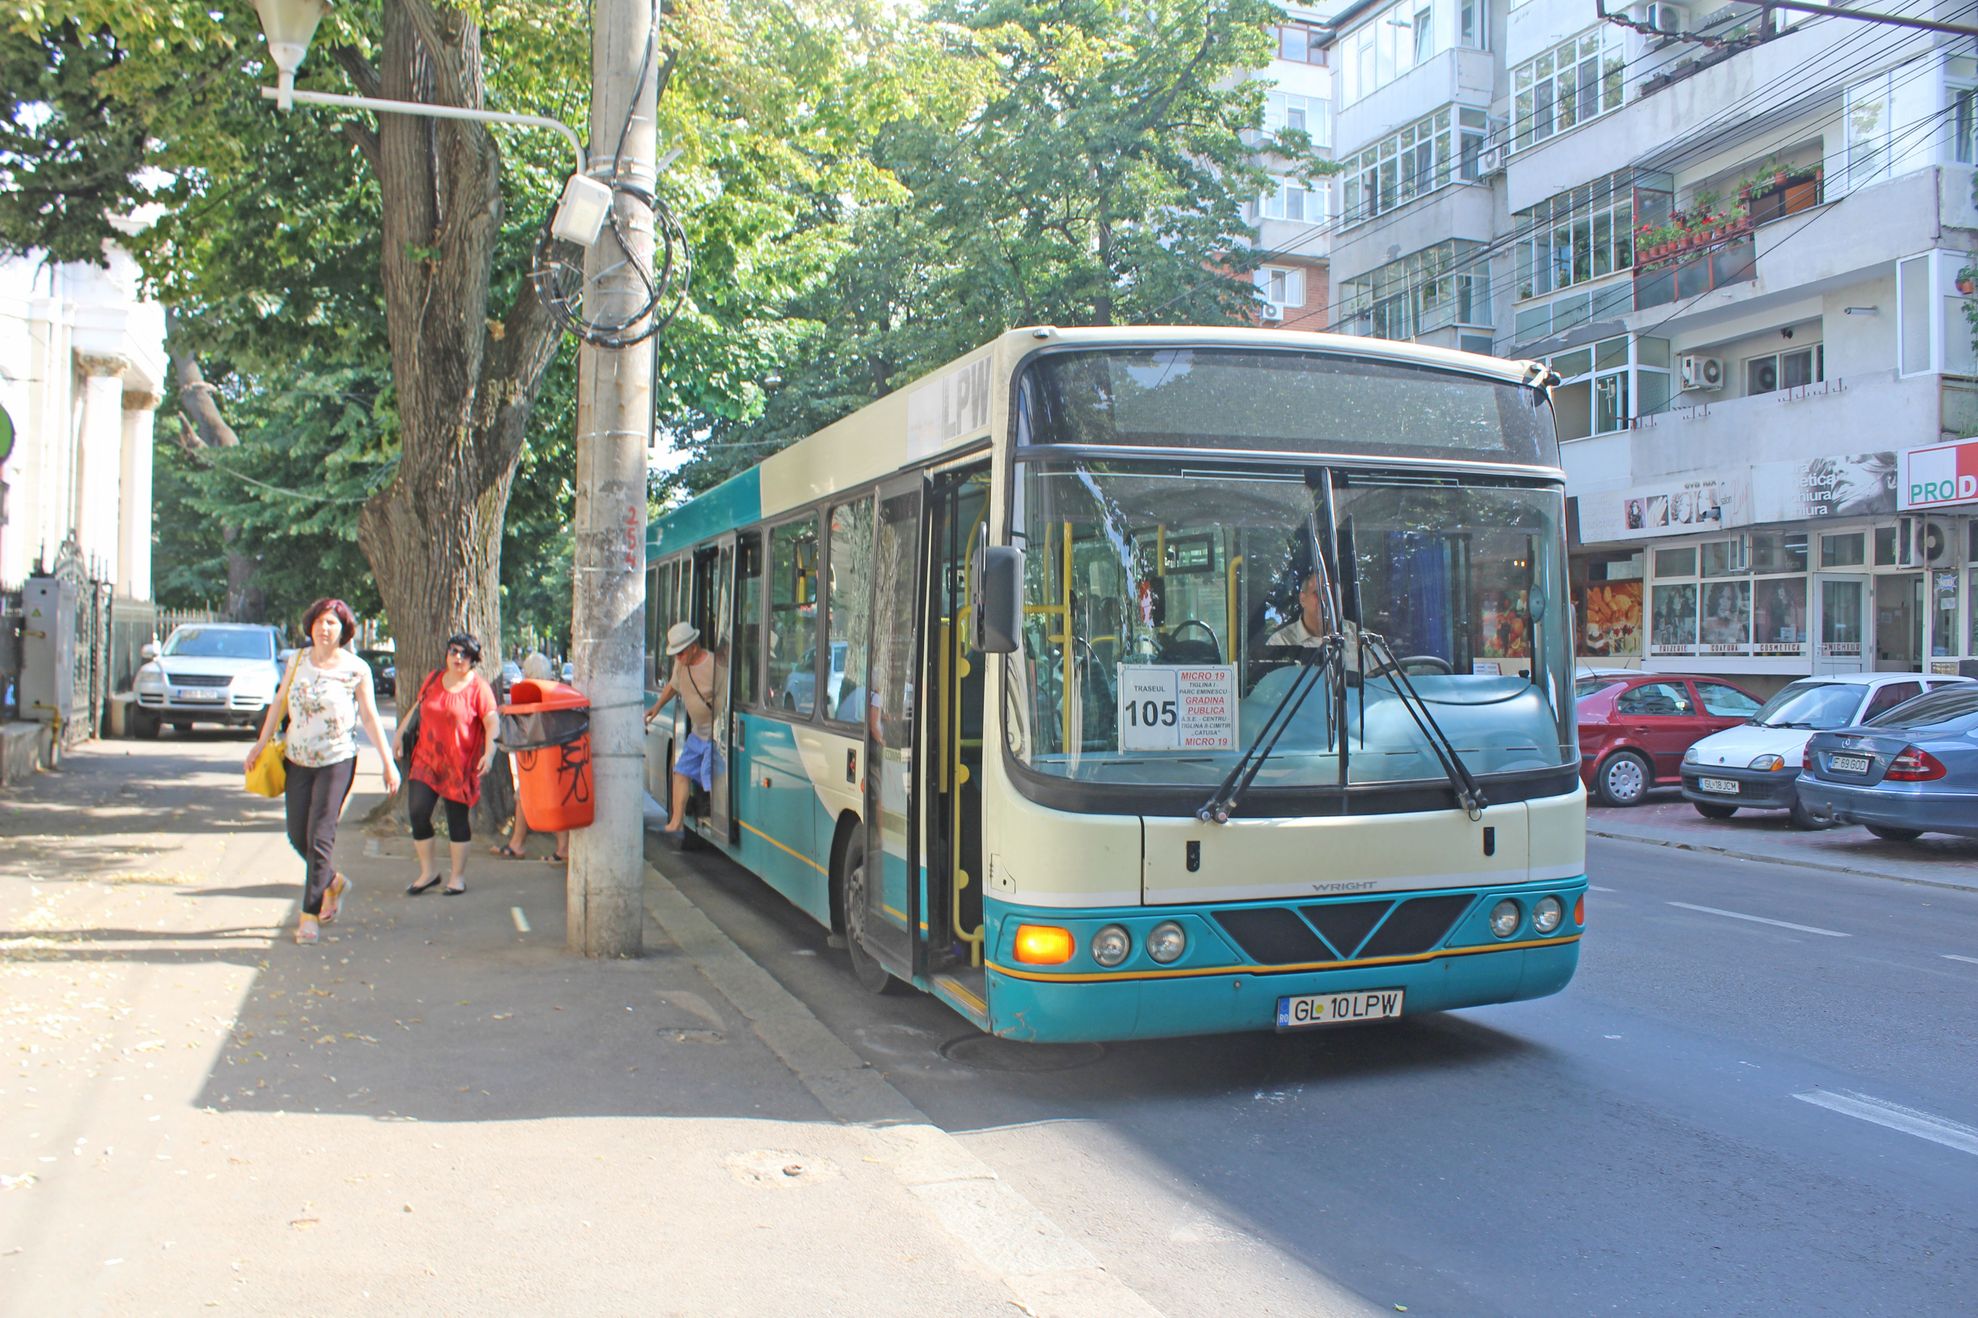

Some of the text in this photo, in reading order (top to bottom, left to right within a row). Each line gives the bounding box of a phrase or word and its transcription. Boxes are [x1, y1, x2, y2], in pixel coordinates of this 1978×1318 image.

[943, 355, 992, 440] LPW
[1799, 473, 1835, 487] etica
[1759, 644, 1800, 652] COSMETICA
[1181, 672, 1225, 681] MICRO 19
[1125, 700, 1177, 727] 105
[1187, 706, 1225, 715] PUBLICA
[1185, 738, 1228, 746] MICRO 19
[1311, 881, 1378, 892] WRIGHT
[1294, 993, 1398, 1021] GL 10 LPW
[1279, 1013, 1289, 1023] RO
